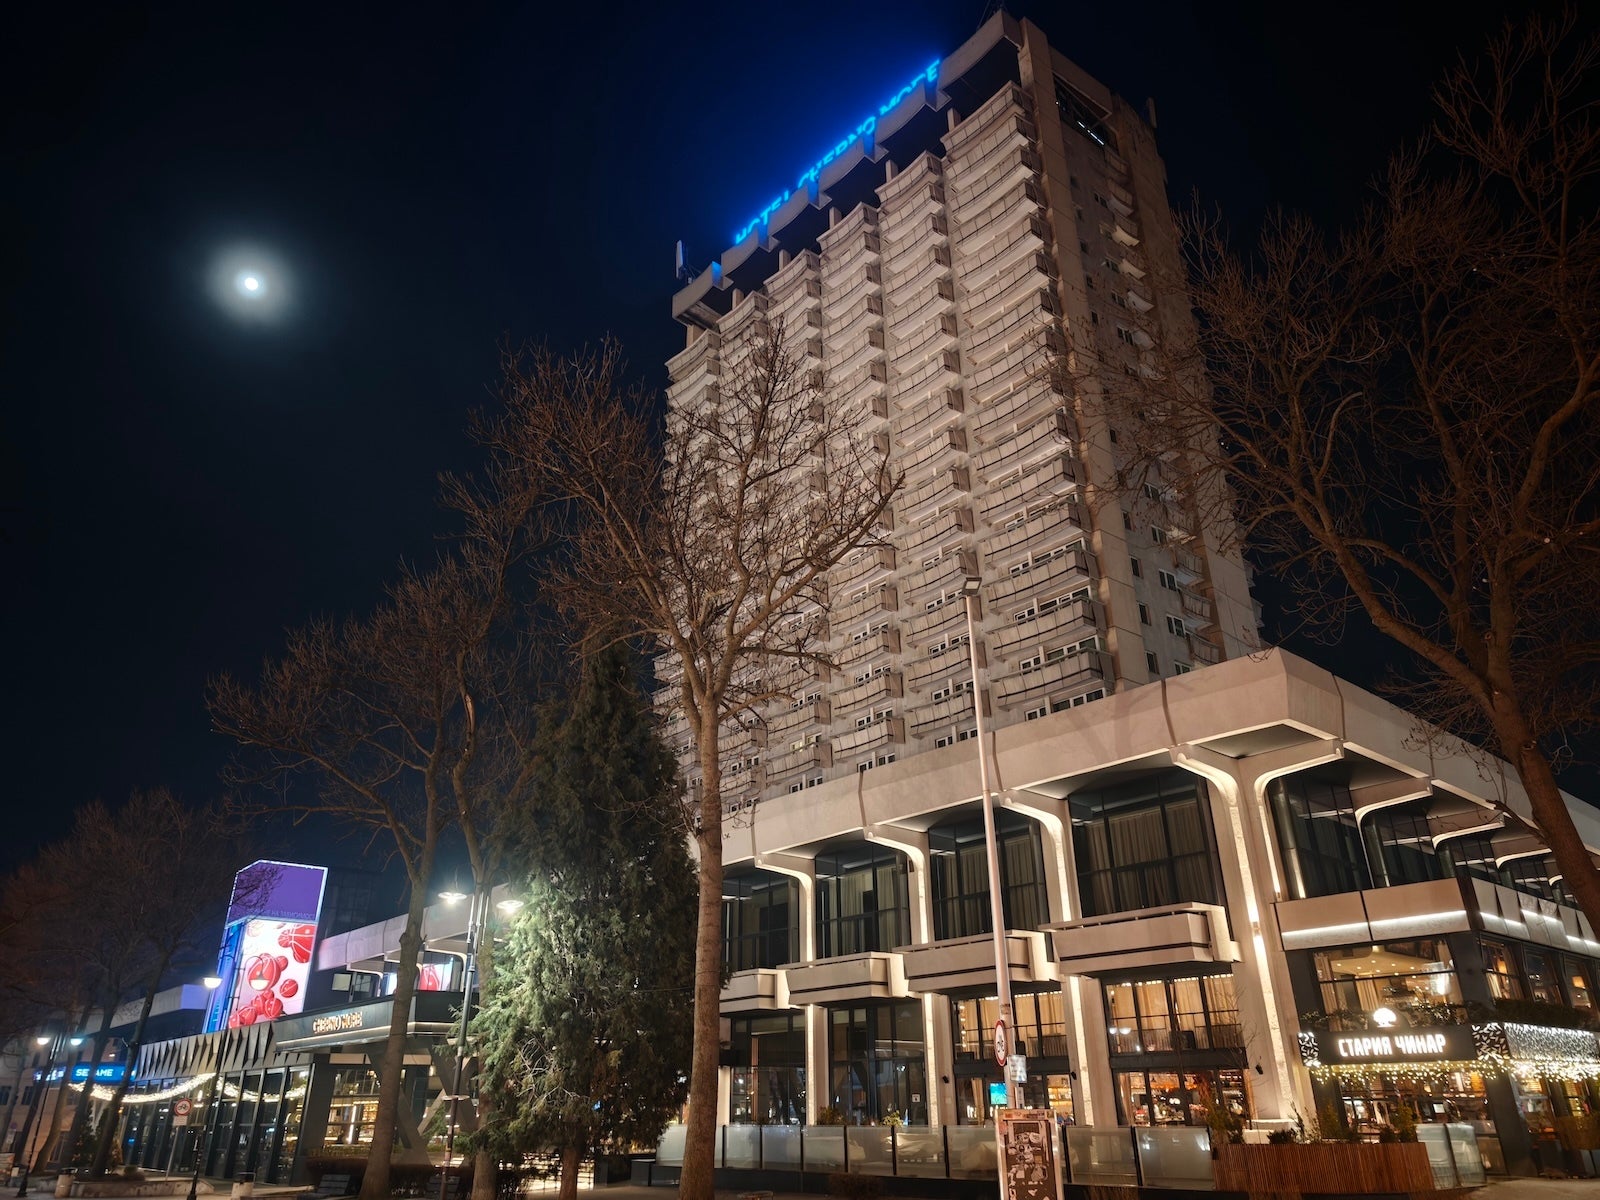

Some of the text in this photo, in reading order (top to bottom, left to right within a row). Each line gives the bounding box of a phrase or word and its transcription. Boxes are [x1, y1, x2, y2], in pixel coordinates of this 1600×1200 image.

[1337, 1033, 1447, 1057] СТАРИЯ ЧИНАР
[75, 1068, 114, 1077] SEAME
